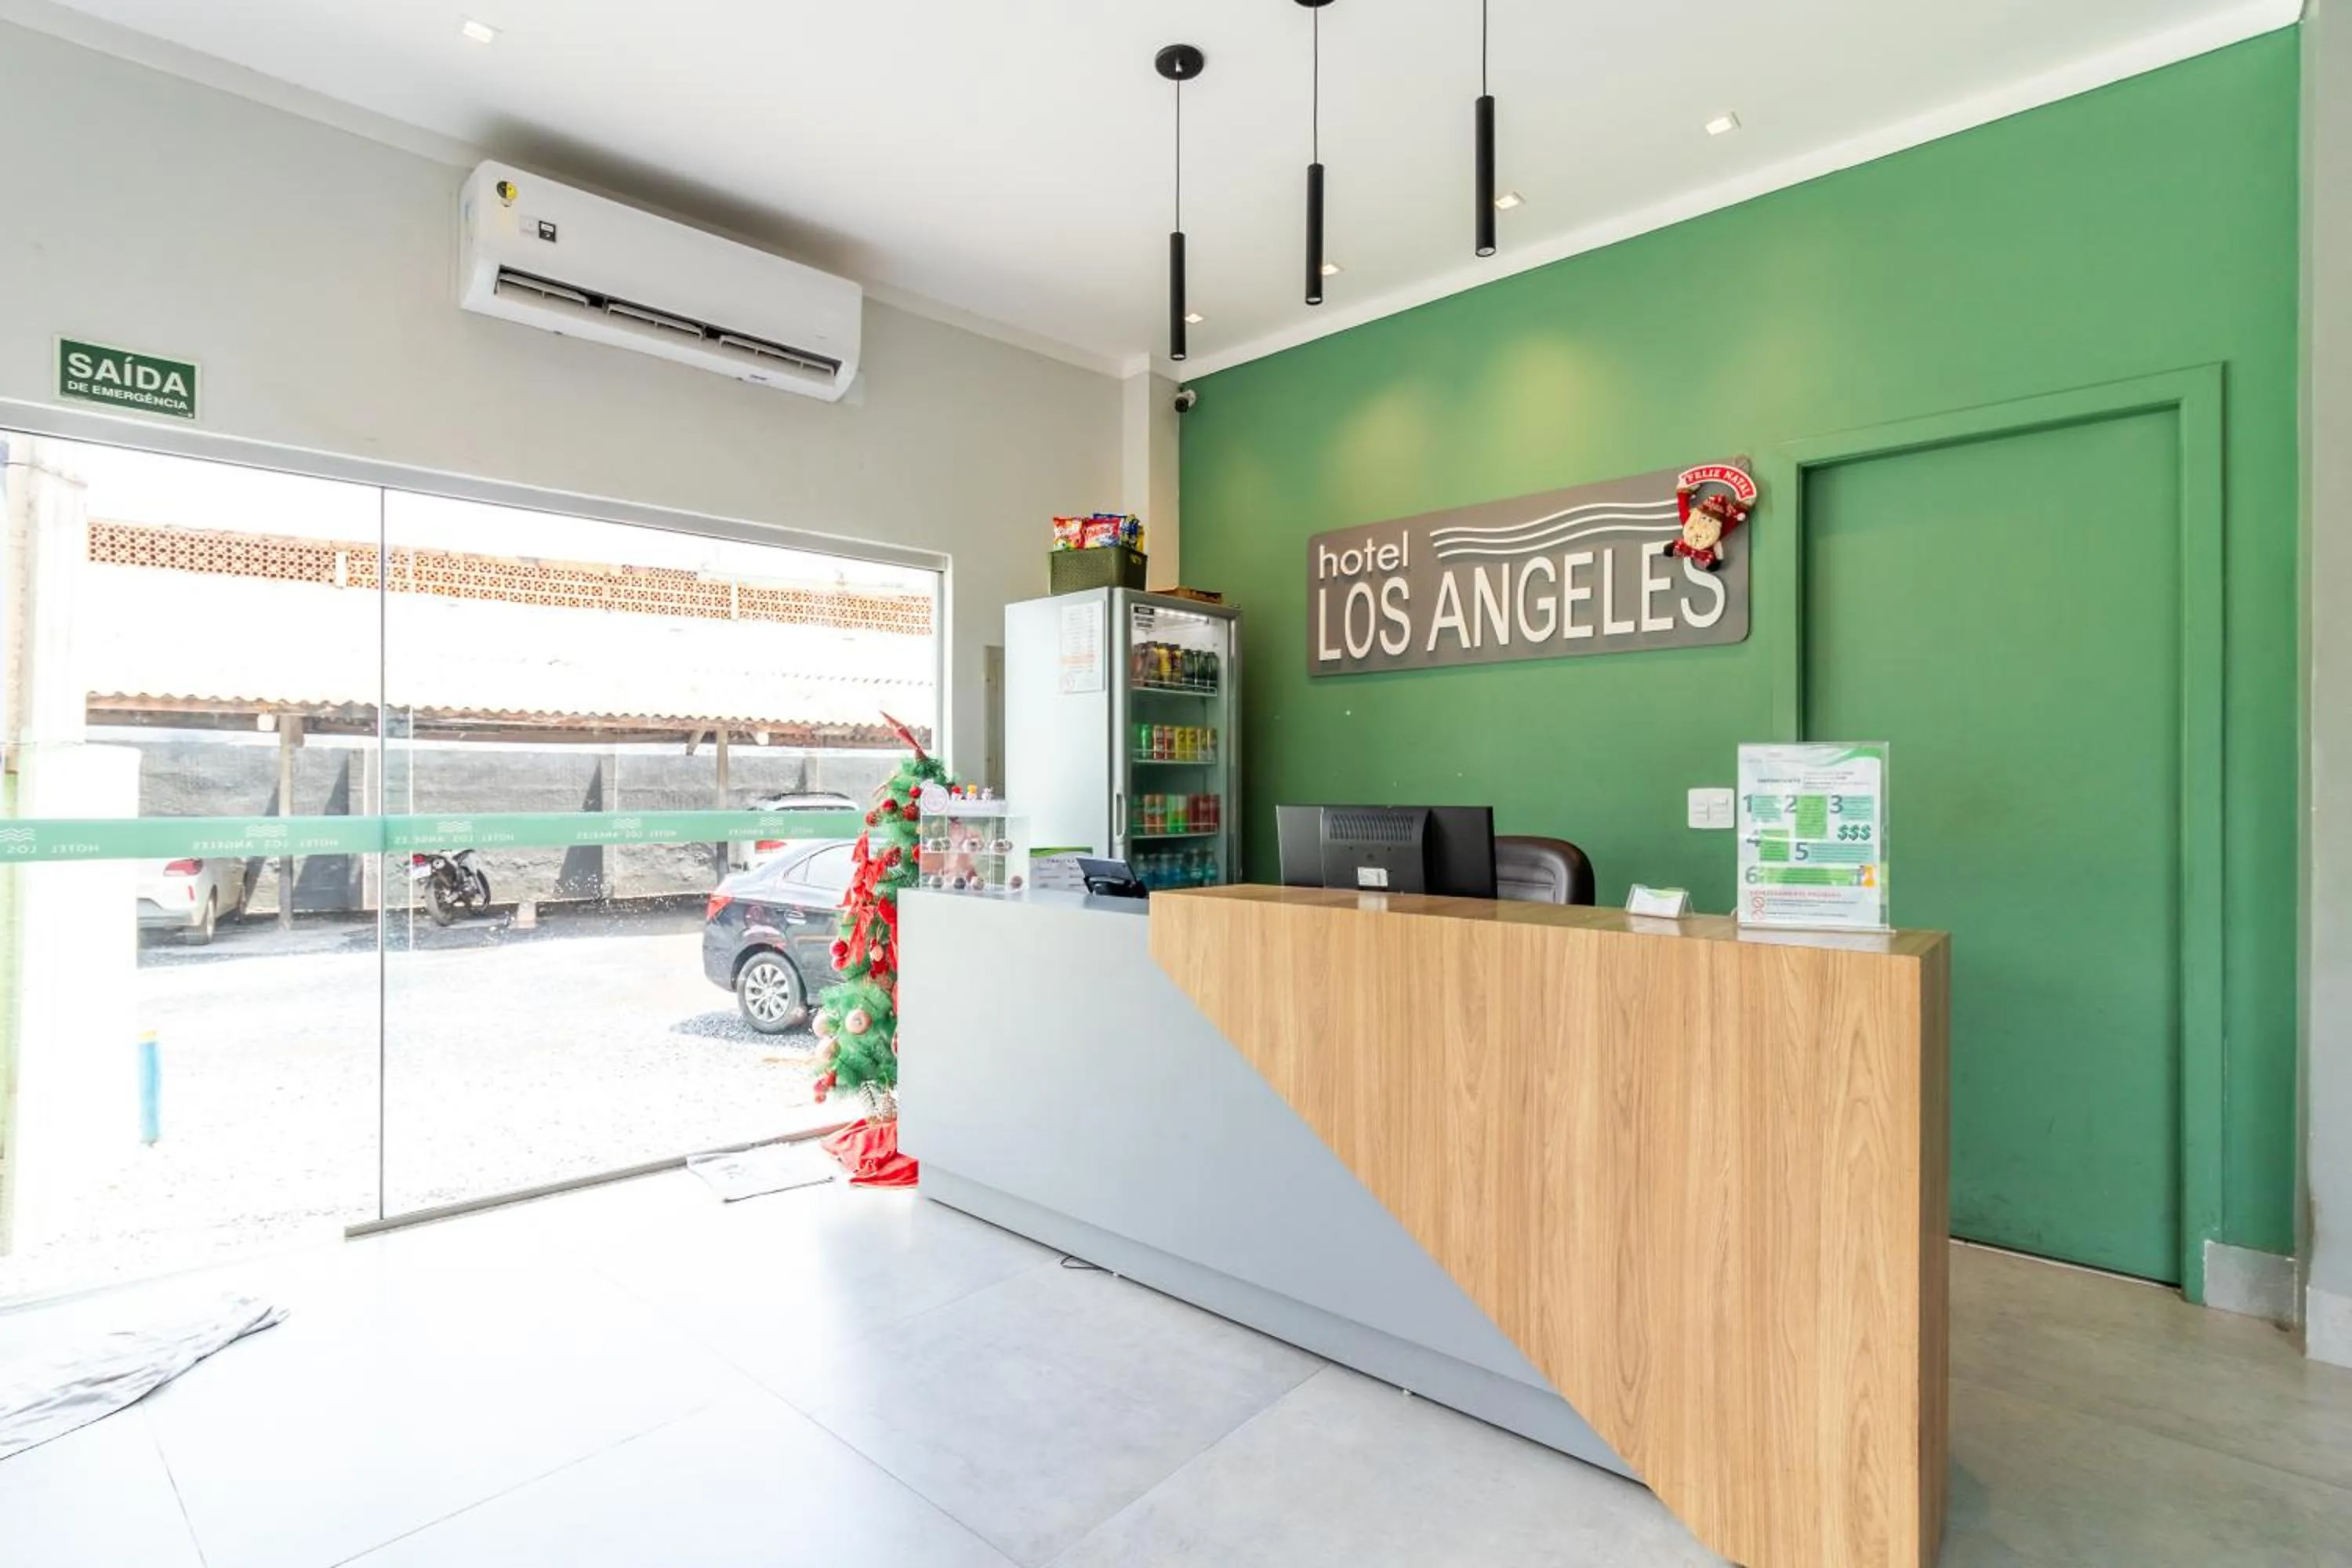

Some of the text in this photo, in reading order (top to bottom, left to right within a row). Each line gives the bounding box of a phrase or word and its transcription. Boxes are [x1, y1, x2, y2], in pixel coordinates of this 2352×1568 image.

[67, 352, 188, 397] SAÍDA
[67, 380, 188, 410] DE EMERGÊNCIA
[1686, 469, 1751, 496] FELIZ NATAL
[1319, 531, 1409, 579] hotel
[1318, 539, 1726, 662] LOS ANGELES
[1743, 794, 1753, 813] 1
[1784, 794, 1798, 814] 2
[1829, 794, 1843, 814] 3
[1795, 842, 1809, 861] 5
[1745, 866, 1759, 884] 6
